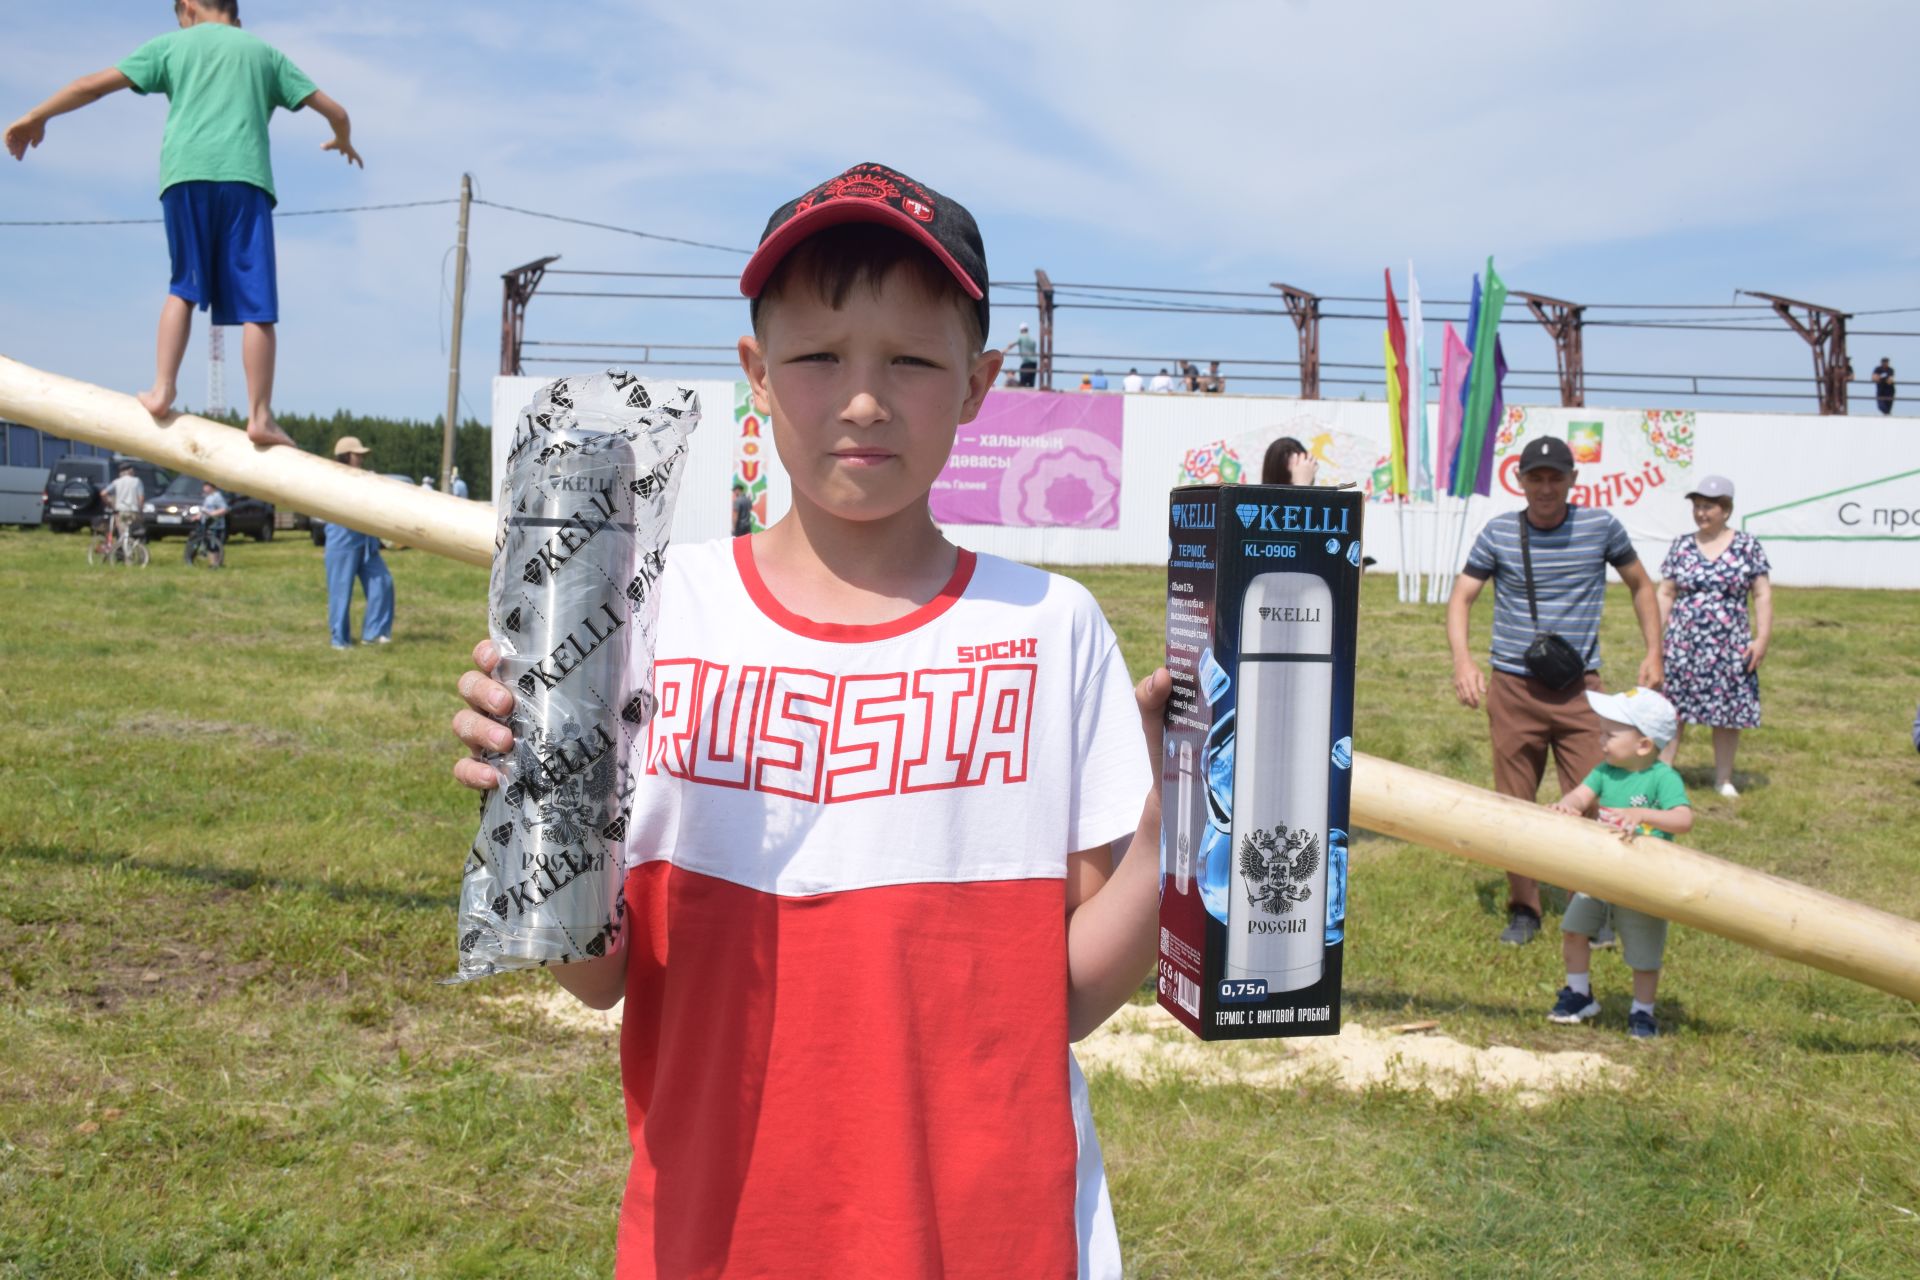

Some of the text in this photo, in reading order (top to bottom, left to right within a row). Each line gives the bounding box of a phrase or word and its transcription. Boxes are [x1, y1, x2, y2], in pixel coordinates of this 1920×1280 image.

[562, 475, 613, 494] KELLI
[1180, 503, 1216, 530] KELLI
[1259, 504, 1350, 534] KELLI
[1838, 502, 1861, 526] С
[537, 487, 621, 576] KELLI
[1179, 544, 1207, 558] ТЕРМОС
[1245, 544, 1296, 558] KL-0906
[1271, 607, 1321, 622] KELLI
[529, 602, 626, 691] KELLI
[957, 638, 1038, 663] SOCHI
[645, 657, 1038, 804] RUSSIA
[1248, 919, 1306, 935] РОССИЯ
[1222, 983, 1265, 998] 0,75л
[1216, 1004, 1330, 1026] ТЕРМОС С ВИНТОВОЙ ПРОБКОЙ
